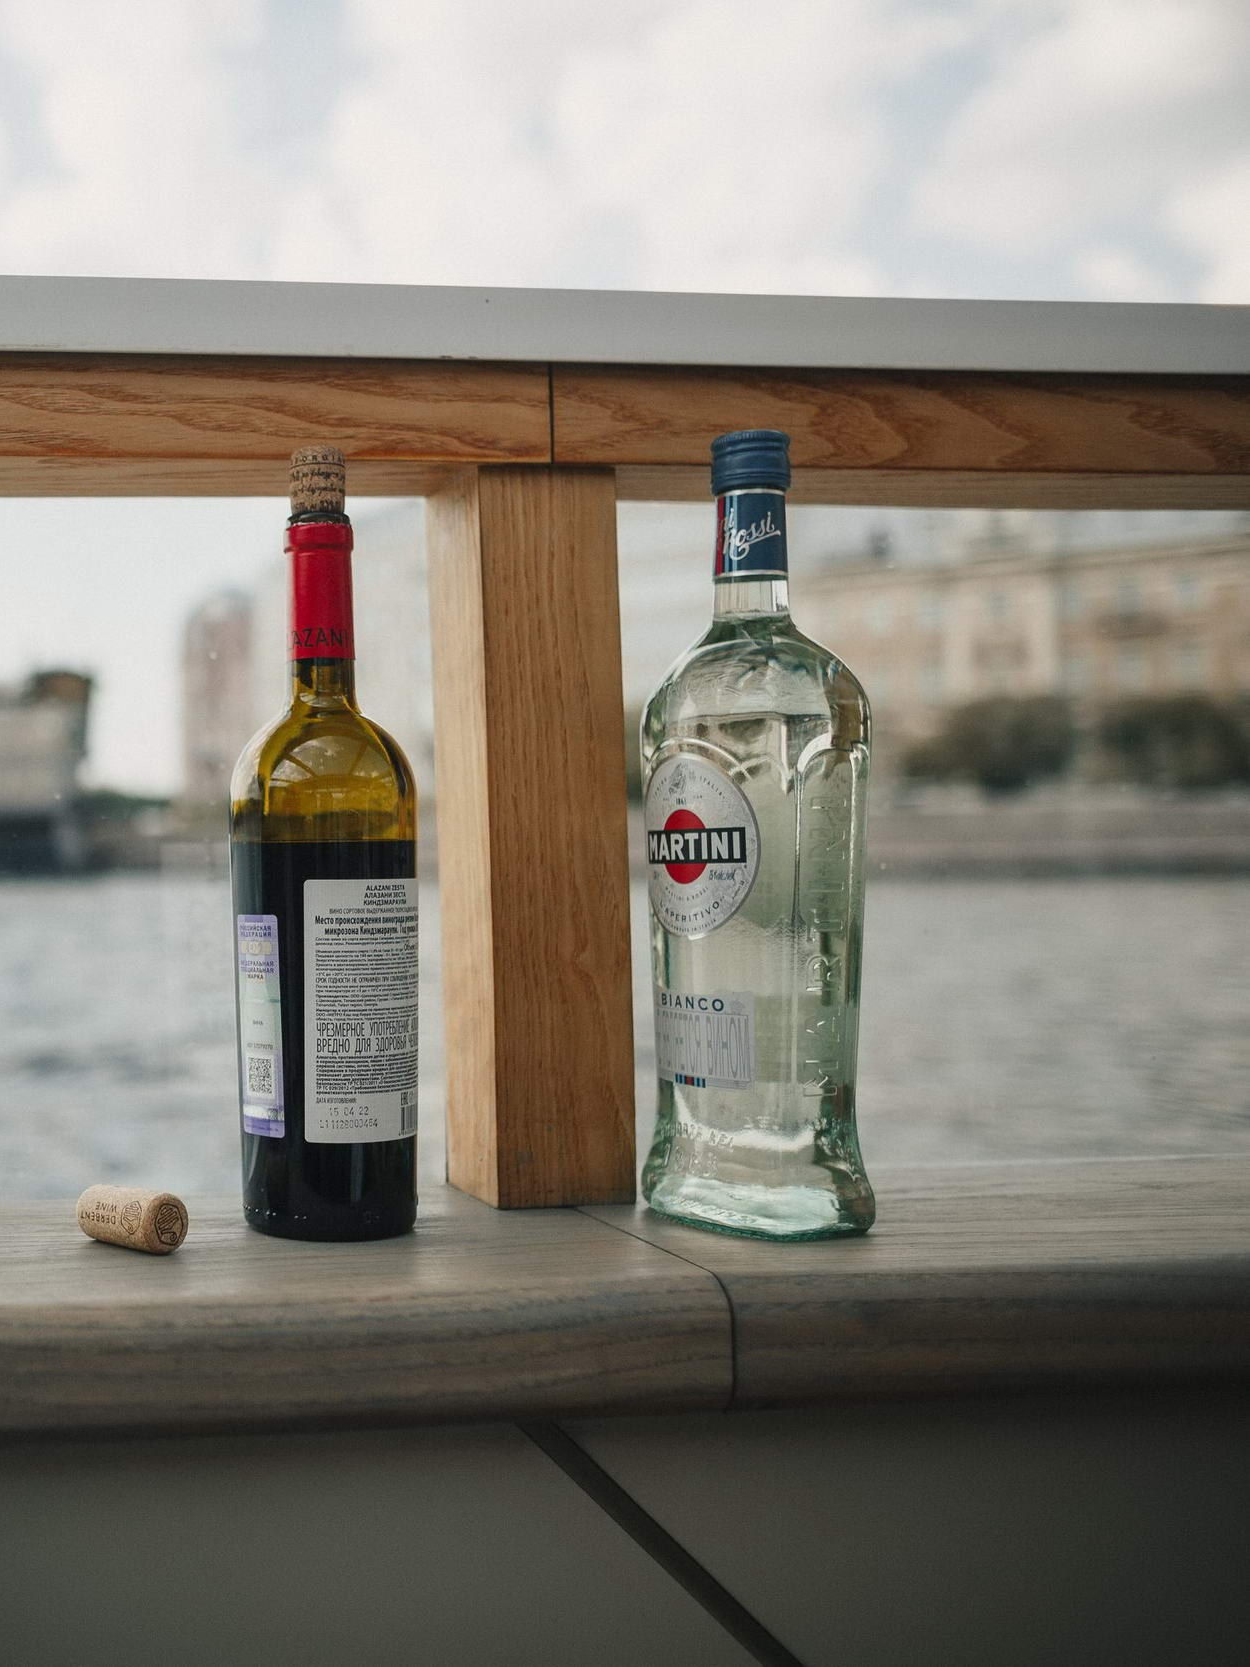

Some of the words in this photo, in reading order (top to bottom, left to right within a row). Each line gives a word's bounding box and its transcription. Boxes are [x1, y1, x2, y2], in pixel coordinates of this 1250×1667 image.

[723, 511, 781, 560] Rossi
[649, 831, 741, 861] MARTINI
[364, 891, 392, 899] АЛАЗАНИ
[363, 898, 407, 906] КИНДЗМАРАУЛИ
[315, 915, 335, 925] Место
[335, 915, 381, 926] происхождения
[324, 927, 359, 937] микрозона
[661, 993, 725, 1012] BIANCO
[316, 1021, 365, 1037] ЧРЕЗМЕРНОЕ
[369, 1019, 409, 1036] УПОТРЕБЛЕНИЕ
[316, 1038, 350, 1055] ВРЕДНО
[354, 1037, 371, 1055] ДЛЯ
[375, 1034, 406, 1053] ЗДОРОВЬЯ
[705, 1015, 751, 1080] ВИНОМ
[315, 1096, 327, 1104] ДАТА
[329, 1107, 339, 1116] 15
[344, 1106, 354, 1116] 04
[359, 1105, 369, 1116] 22
[95, 1201, 117, 1213] WINE
[80, 1210, 117, 1225] DERBENT
